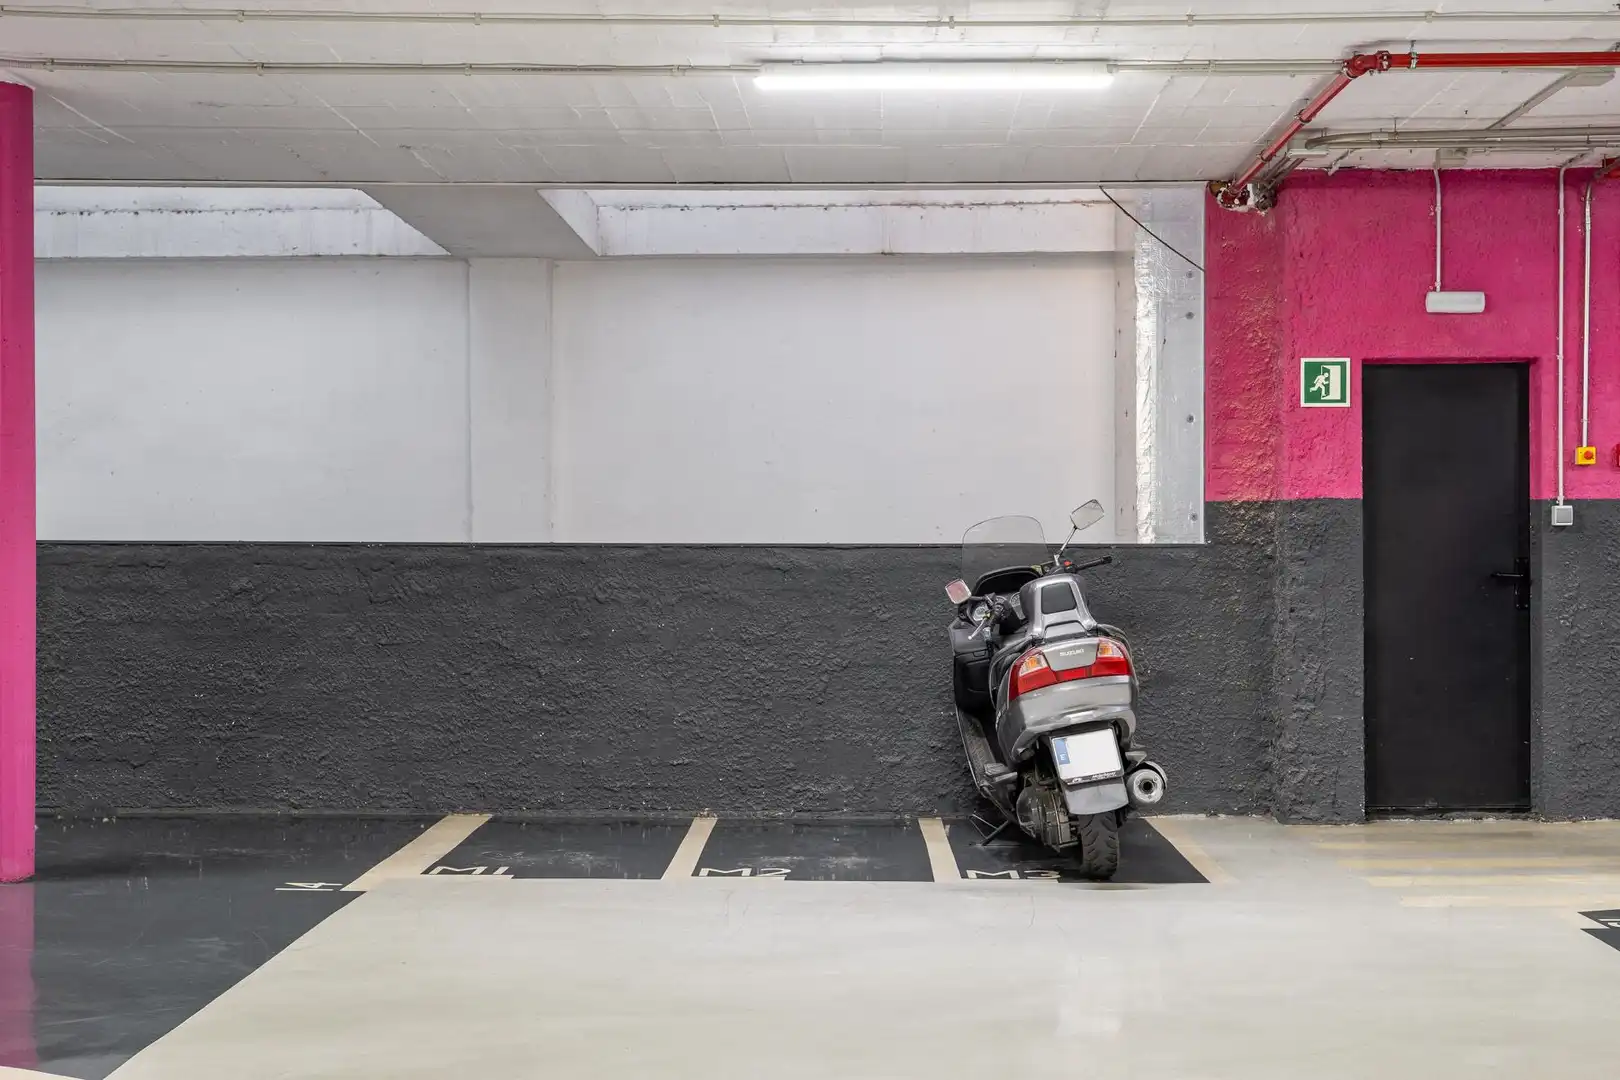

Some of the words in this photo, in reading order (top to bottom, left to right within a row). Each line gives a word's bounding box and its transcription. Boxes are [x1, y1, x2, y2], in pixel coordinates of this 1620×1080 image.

[1059, 752, 1067, 761] E
[699, 867, 792, 877] M2
[966, 869, 1062, 880] M3
